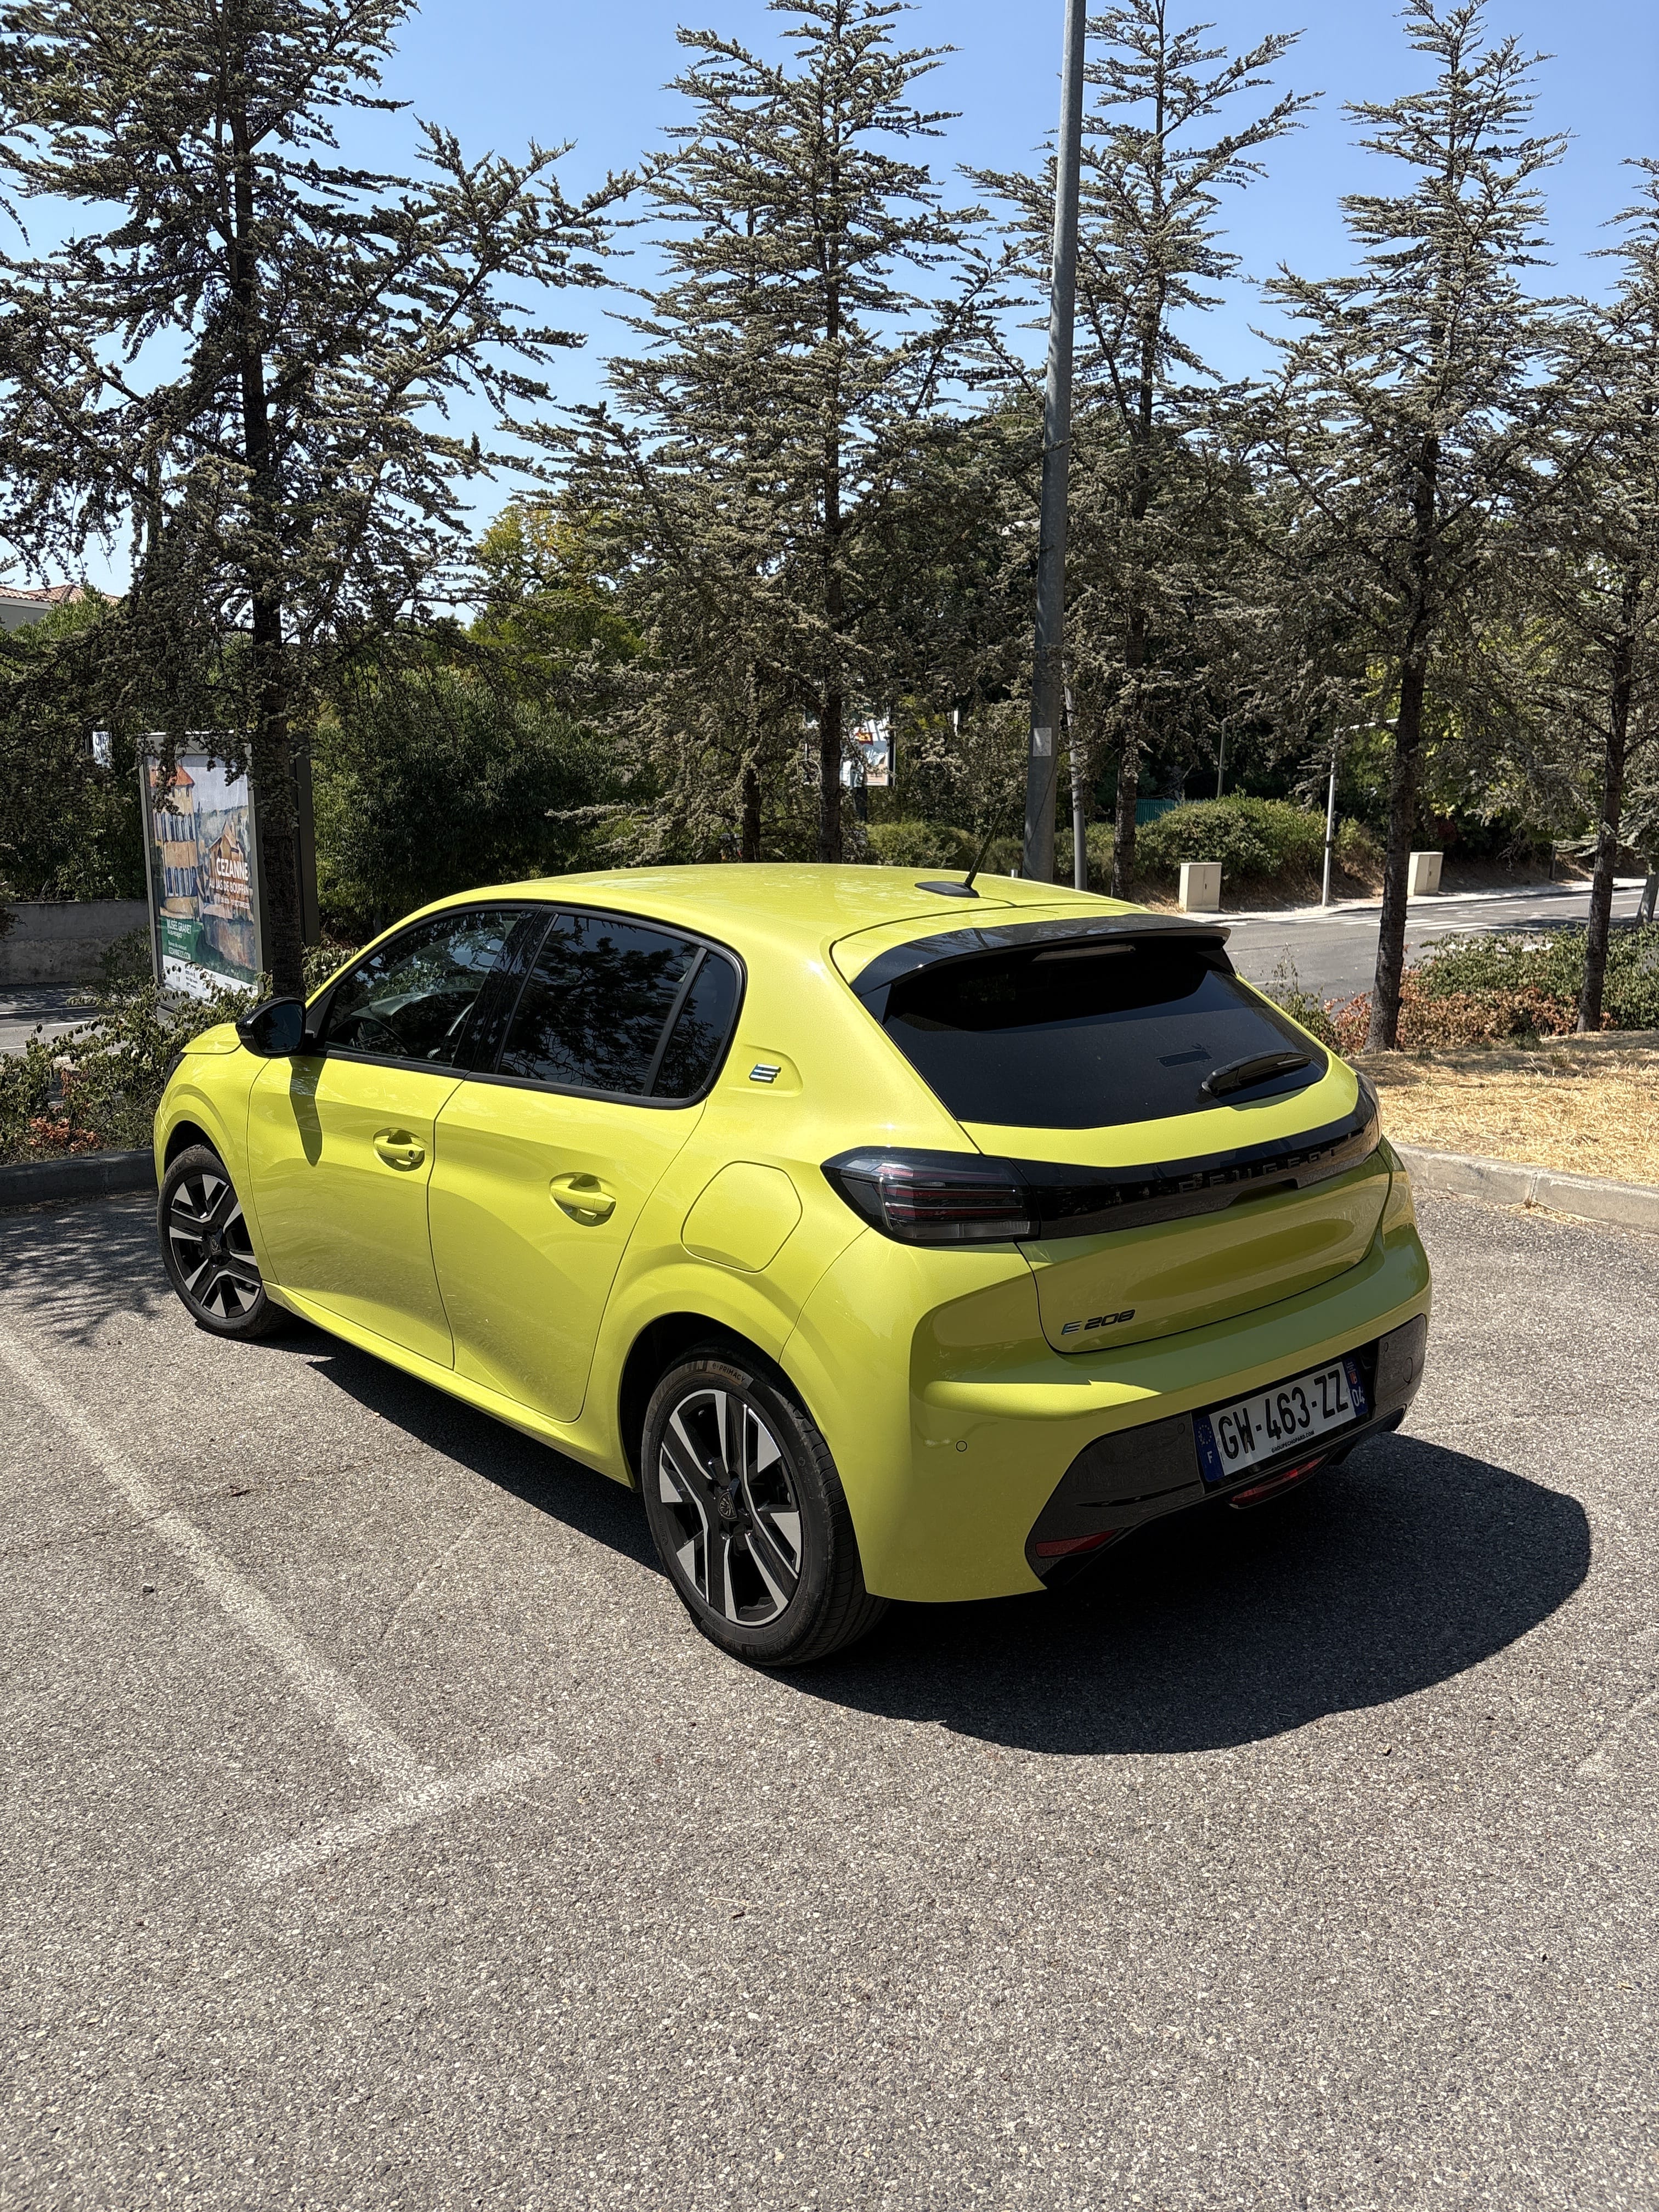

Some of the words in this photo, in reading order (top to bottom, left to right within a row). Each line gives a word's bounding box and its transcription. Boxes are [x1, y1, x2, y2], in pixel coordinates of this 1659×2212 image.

[216, 857, 249, 881] CEZANNE
[209, 878, 215, 889] AU
[223, 881, 229, 891] DE
[230, 882, 249, 896] BOUFFAN
[1084, 1308, 1136, 1330] 208
[1351, 1387, 1365, 1407] 04
[1218, 1369, 1349, 1459] GW-463-ZZ
[1271, 1430, 1315, 1453] GROUPECHOPARD.COM
[1206, 1451, 1214, 1464] F
